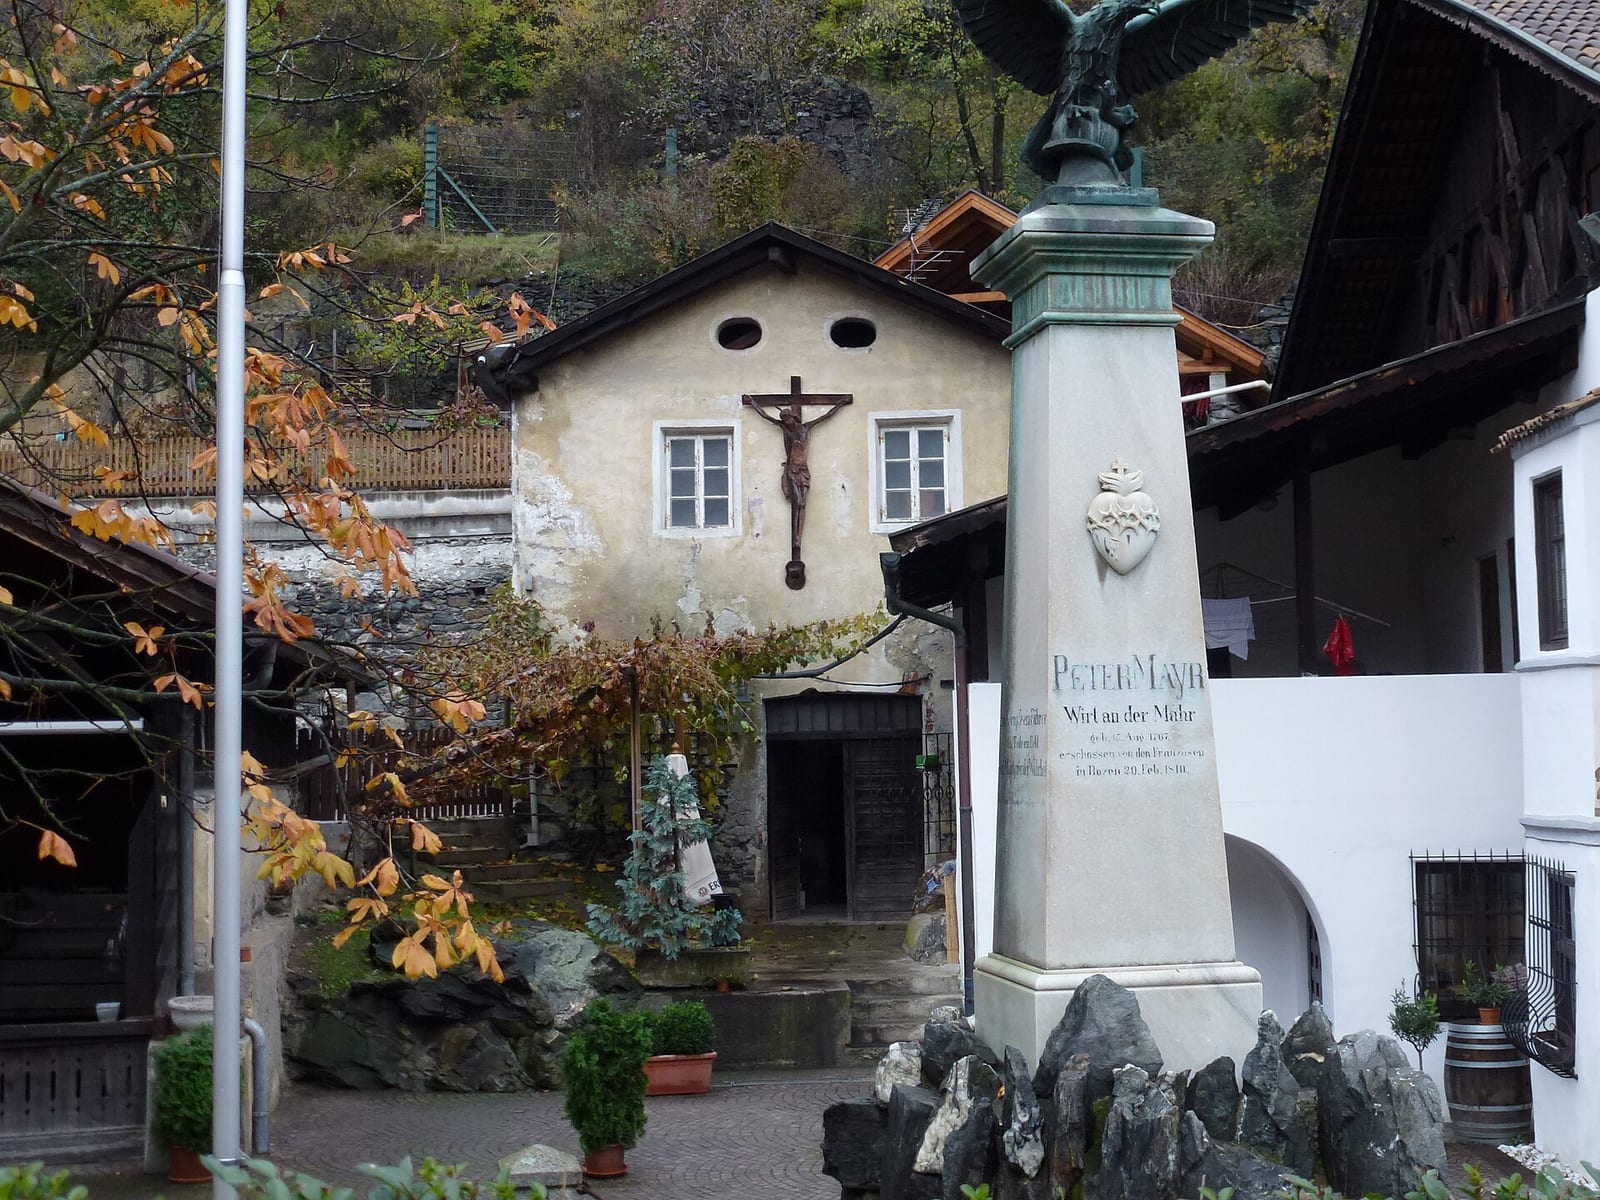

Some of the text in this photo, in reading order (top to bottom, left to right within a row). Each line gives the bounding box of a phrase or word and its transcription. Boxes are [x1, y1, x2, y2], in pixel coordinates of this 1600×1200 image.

[1063, 706, 1098, 725] Wirt
[1102, 711, 1119, 724] an
[1124, 705, 1150, 724] der
[1154, 704, 1197, 723] Mahr
[1135, 747, 1151, 759] den
[1076, 765, 1086, 777] in
[1088, 764, 1121, 777] Bozen
